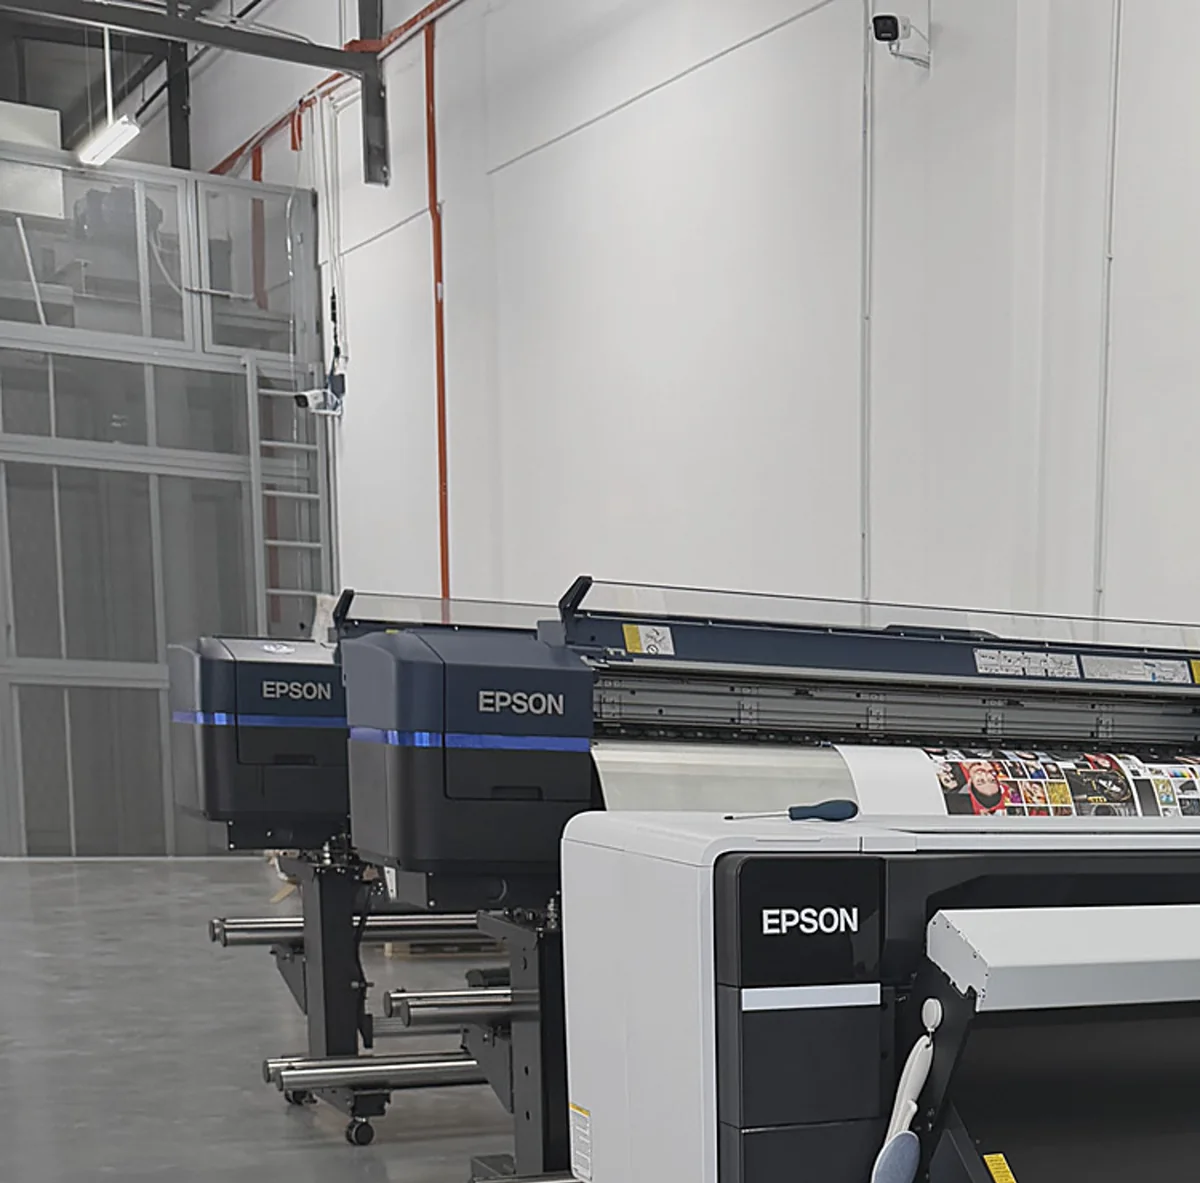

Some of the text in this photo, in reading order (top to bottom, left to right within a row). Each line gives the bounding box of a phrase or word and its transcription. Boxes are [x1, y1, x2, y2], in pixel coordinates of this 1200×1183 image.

[262, 680, 332, 701] EPSON
[478, 690, 565, 716] EPSON
[762, 907, 858, 934] EPSON
